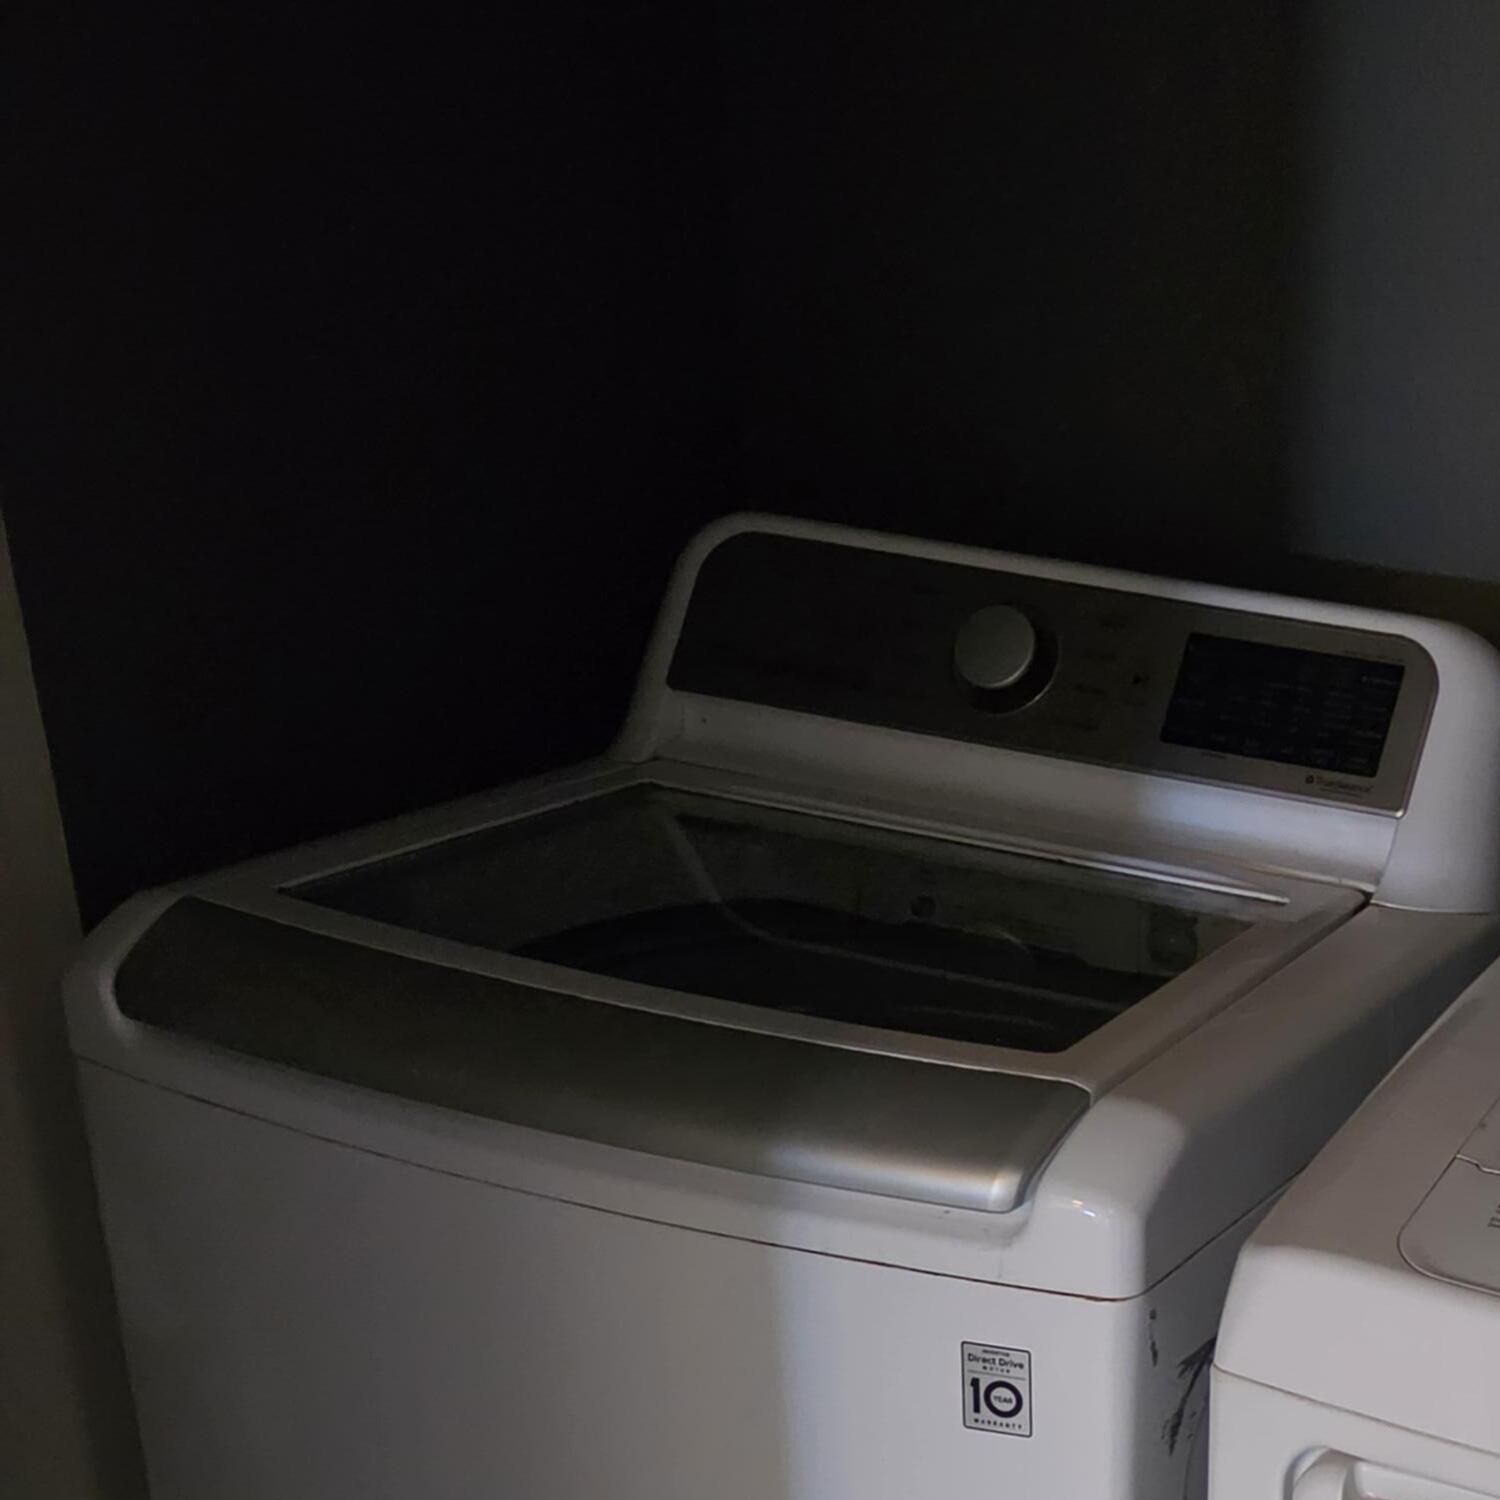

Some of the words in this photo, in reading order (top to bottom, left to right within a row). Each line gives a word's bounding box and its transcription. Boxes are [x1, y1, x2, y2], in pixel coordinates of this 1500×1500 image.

[967, 1352, 997, 1366] Direct
[998, 1358, 1025, 1370] Drive
[970, 1377, 1023, 1419] 10
